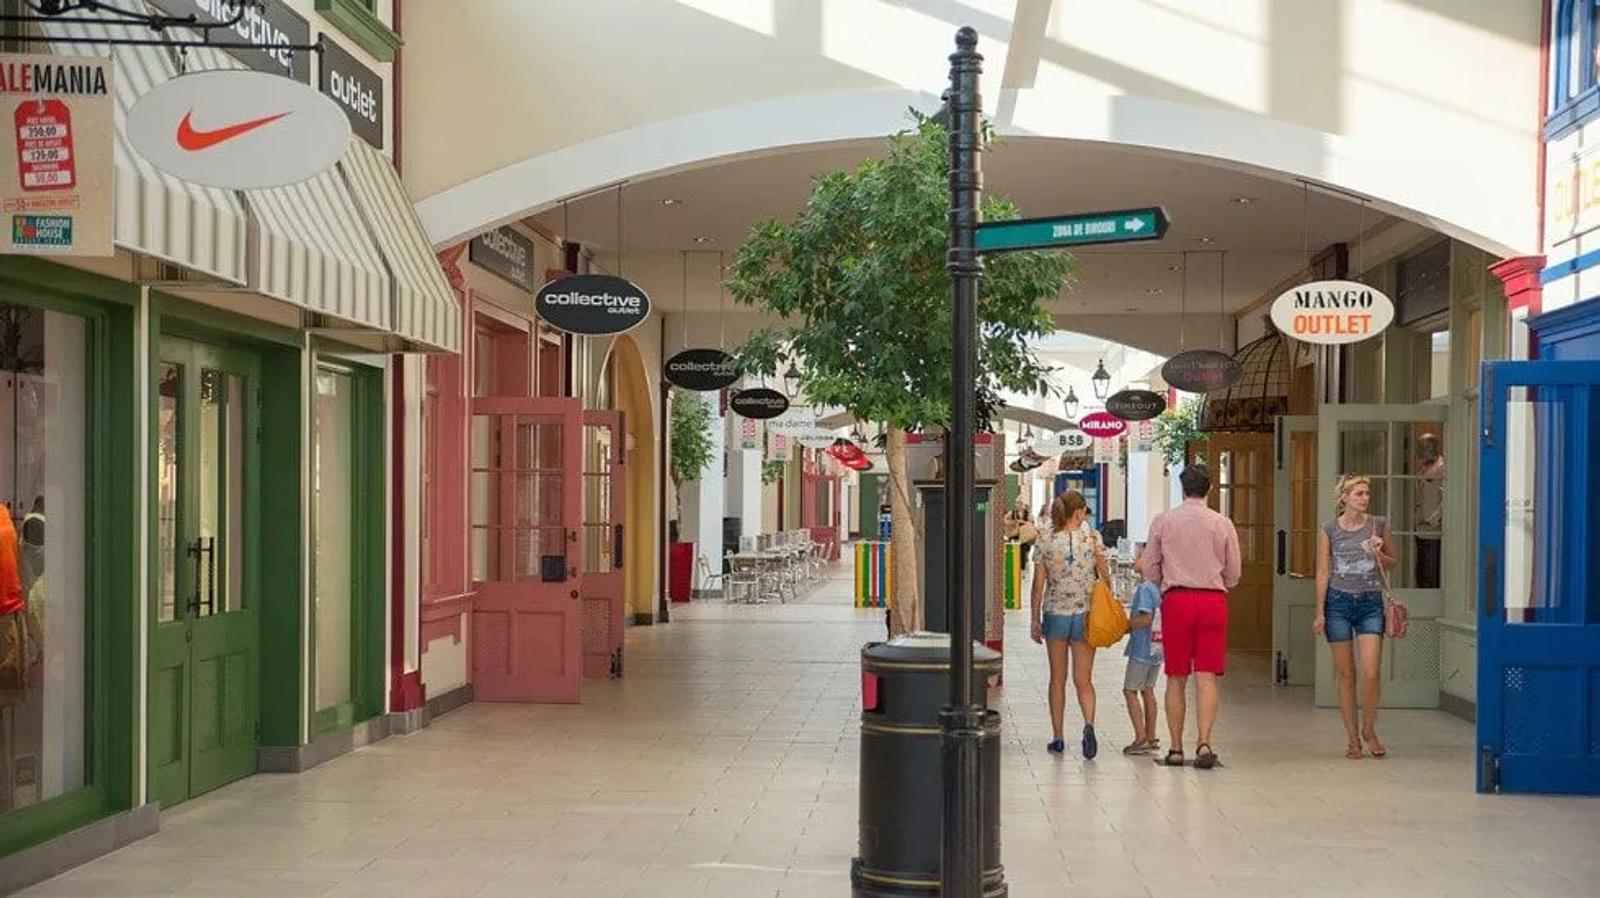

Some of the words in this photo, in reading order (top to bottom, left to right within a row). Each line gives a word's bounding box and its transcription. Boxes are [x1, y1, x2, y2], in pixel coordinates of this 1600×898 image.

[331, 70, 376, 122] outlet
[545, 292, 640, 307] collective
[1295, 291, 1373, 308] MANGO
[607, 307, 640, 315] outlet
[1294, 315, 1371, 334] OUTLET
[1082, 420, 1123, 430] MIRANO
[1060, 435, 1083, 446] BSB
